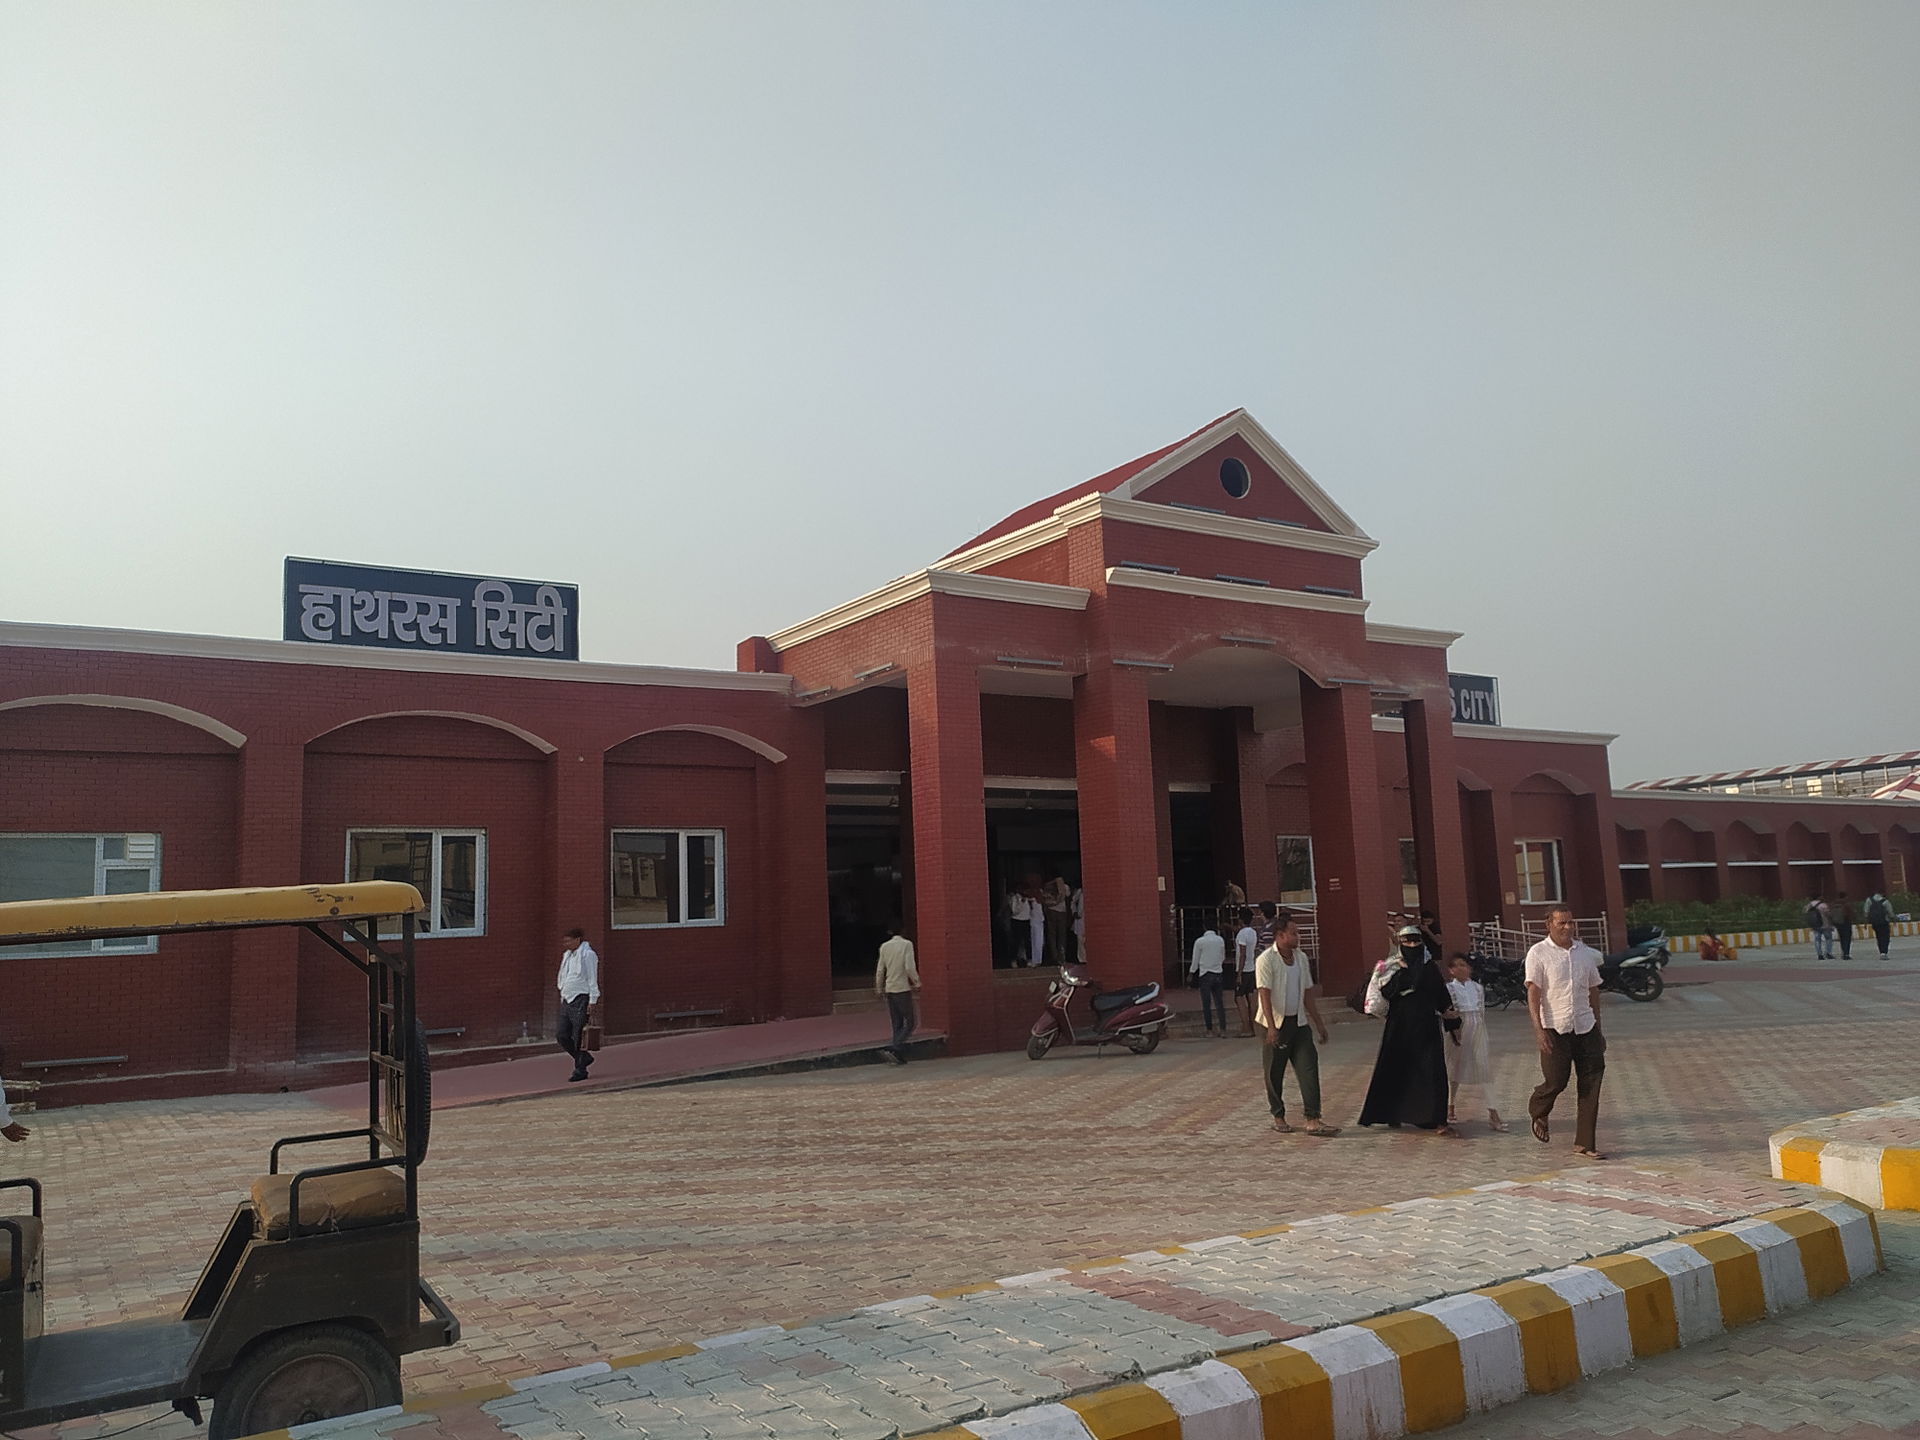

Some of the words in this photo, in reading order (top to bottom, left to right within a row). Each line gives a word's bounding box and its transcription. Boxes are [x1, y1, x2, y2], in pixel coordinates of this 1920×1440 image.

[299, 584, 461, 645] हाथरस
[472, 580, 568, 652] सिटी
[1460, 688, 1495, 722] CITY
